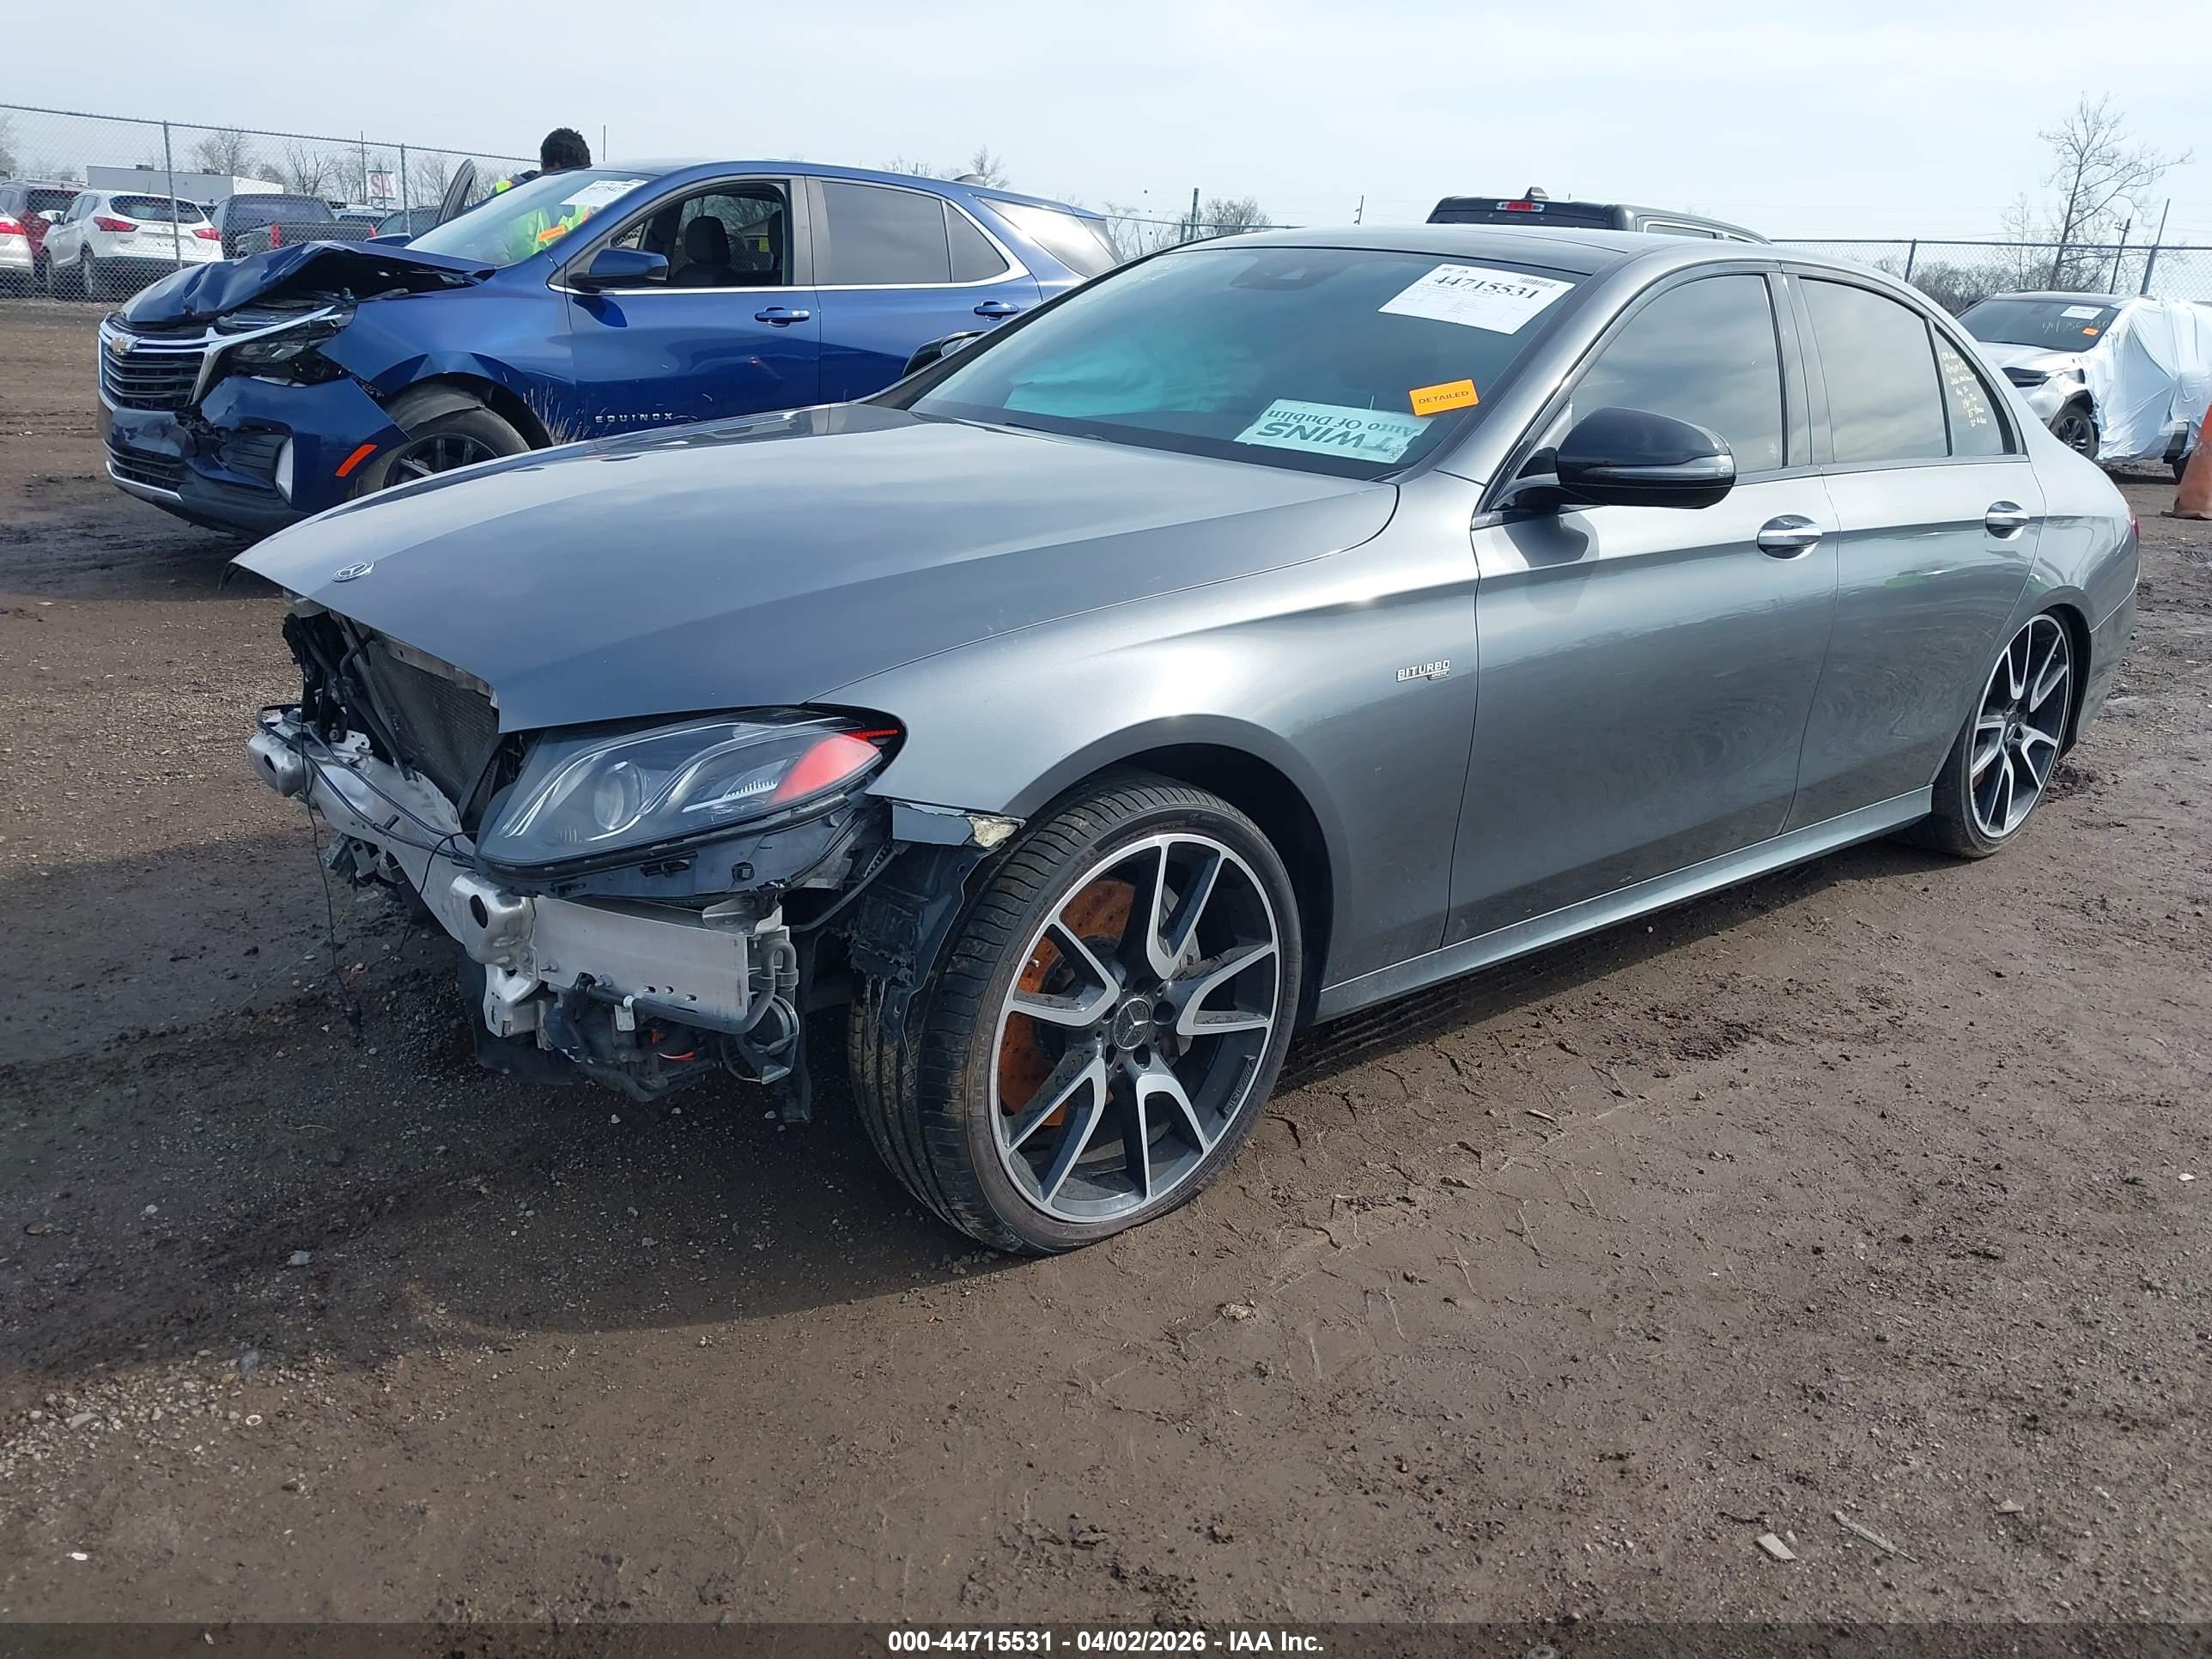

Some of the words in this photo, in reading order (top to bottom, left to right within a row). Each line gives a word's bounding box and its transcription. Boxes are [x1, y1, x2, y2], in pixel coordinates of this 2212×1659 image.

[1433, 275, 1540, 300] 44715531
[1419, 391, 1469, 404] DETAILED
[595, 412, 673, 423] EQUINOX
[1267, 410, 1333, 427] Dublin
[1333, 416, 1364, 429] Of
[1367, 422, 1419, 438] Auto
[1397, 659, 1450, 678] BITURBO
